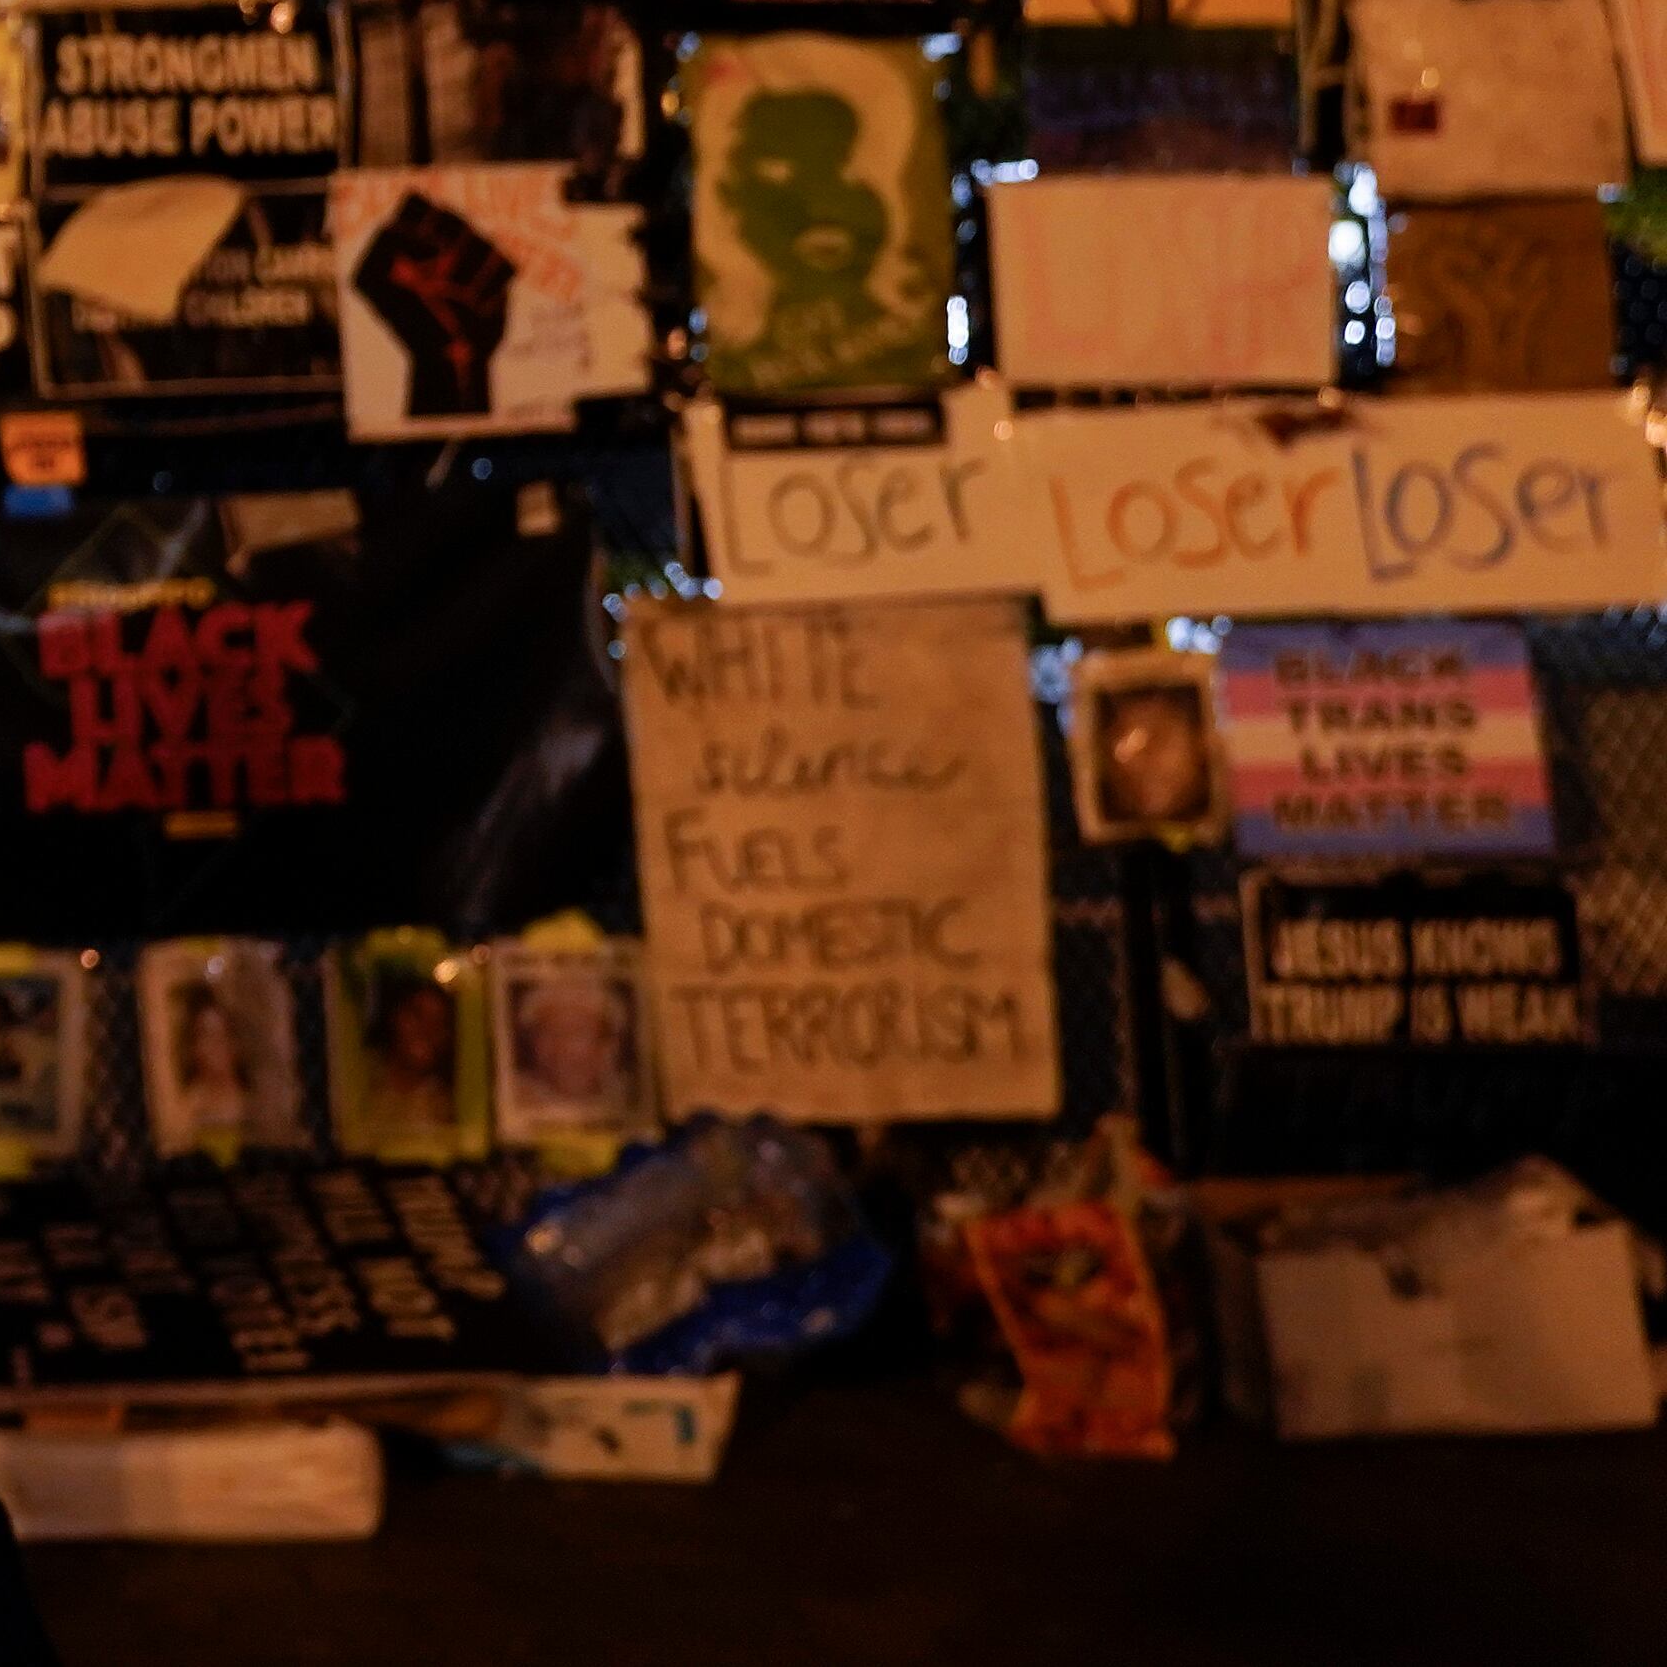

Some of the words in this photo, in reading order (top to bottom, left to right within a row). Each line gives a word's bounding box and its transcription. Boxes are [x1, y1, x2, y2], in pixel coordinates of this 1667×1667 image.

[54, 33, 319, 94] STRONGMEN
[40, 97, 182, 157] ABUSE
[188, 93, 340, 156] POWER
[35, 598, 321, 680] BLACK
[639, 613, 880, 711] WHITE
[1274, 648, 1467, 689] BLACK
[69, 672, 295, 742] LIVES
[1288, 697, 1478, 731] TRANS
[21, 732, 351, 814] MATTER
[1300, 744, 1471, 783] LIVES
[1273, 790, 1515, 827] MATTER
[699, 896, 986, 974] DOMESTIC
